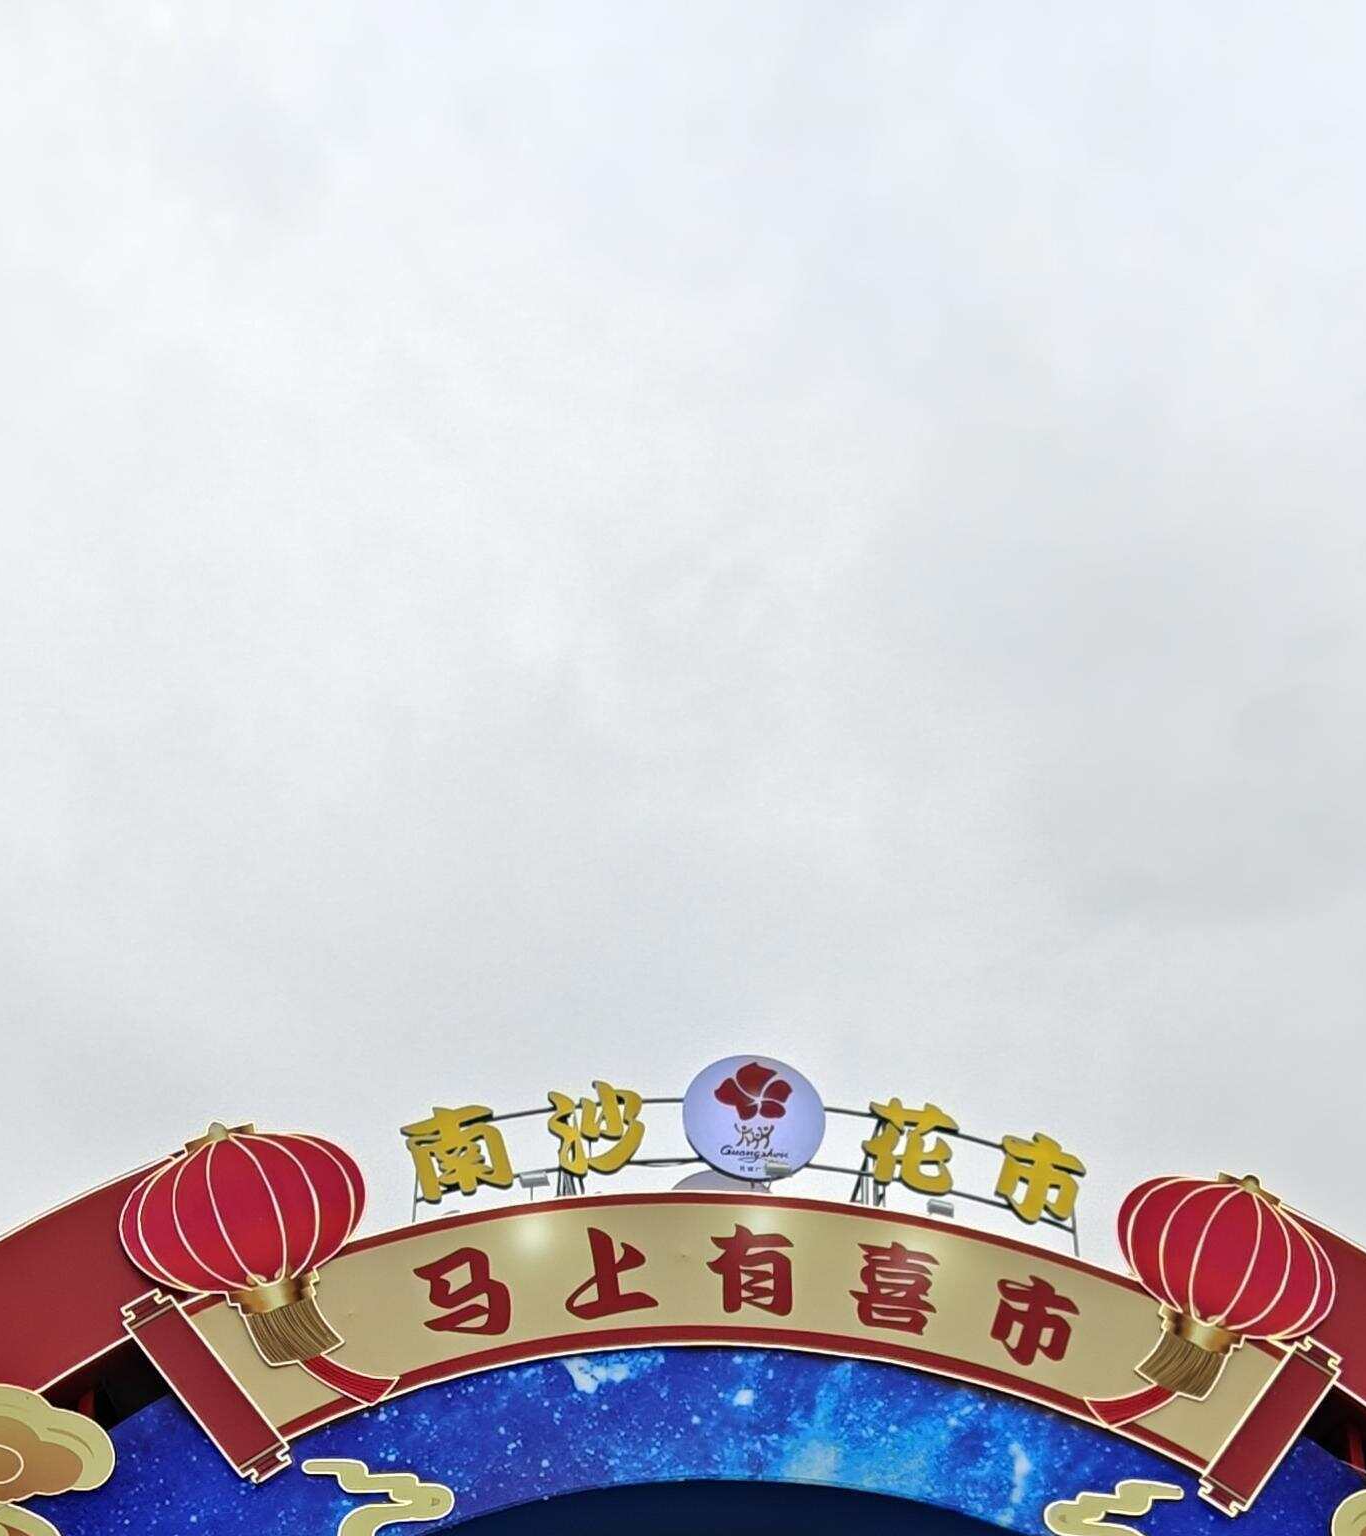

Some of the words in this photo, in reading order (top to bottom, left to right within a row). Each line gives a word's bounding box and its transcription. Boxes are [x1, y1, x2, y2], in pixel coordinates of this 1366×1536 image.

[401, 1080, 646, 1203] 南沙
[862, 1098, 1087, 1225] 花市
[414, 1224, 1081, 1366] 马上有喜市
